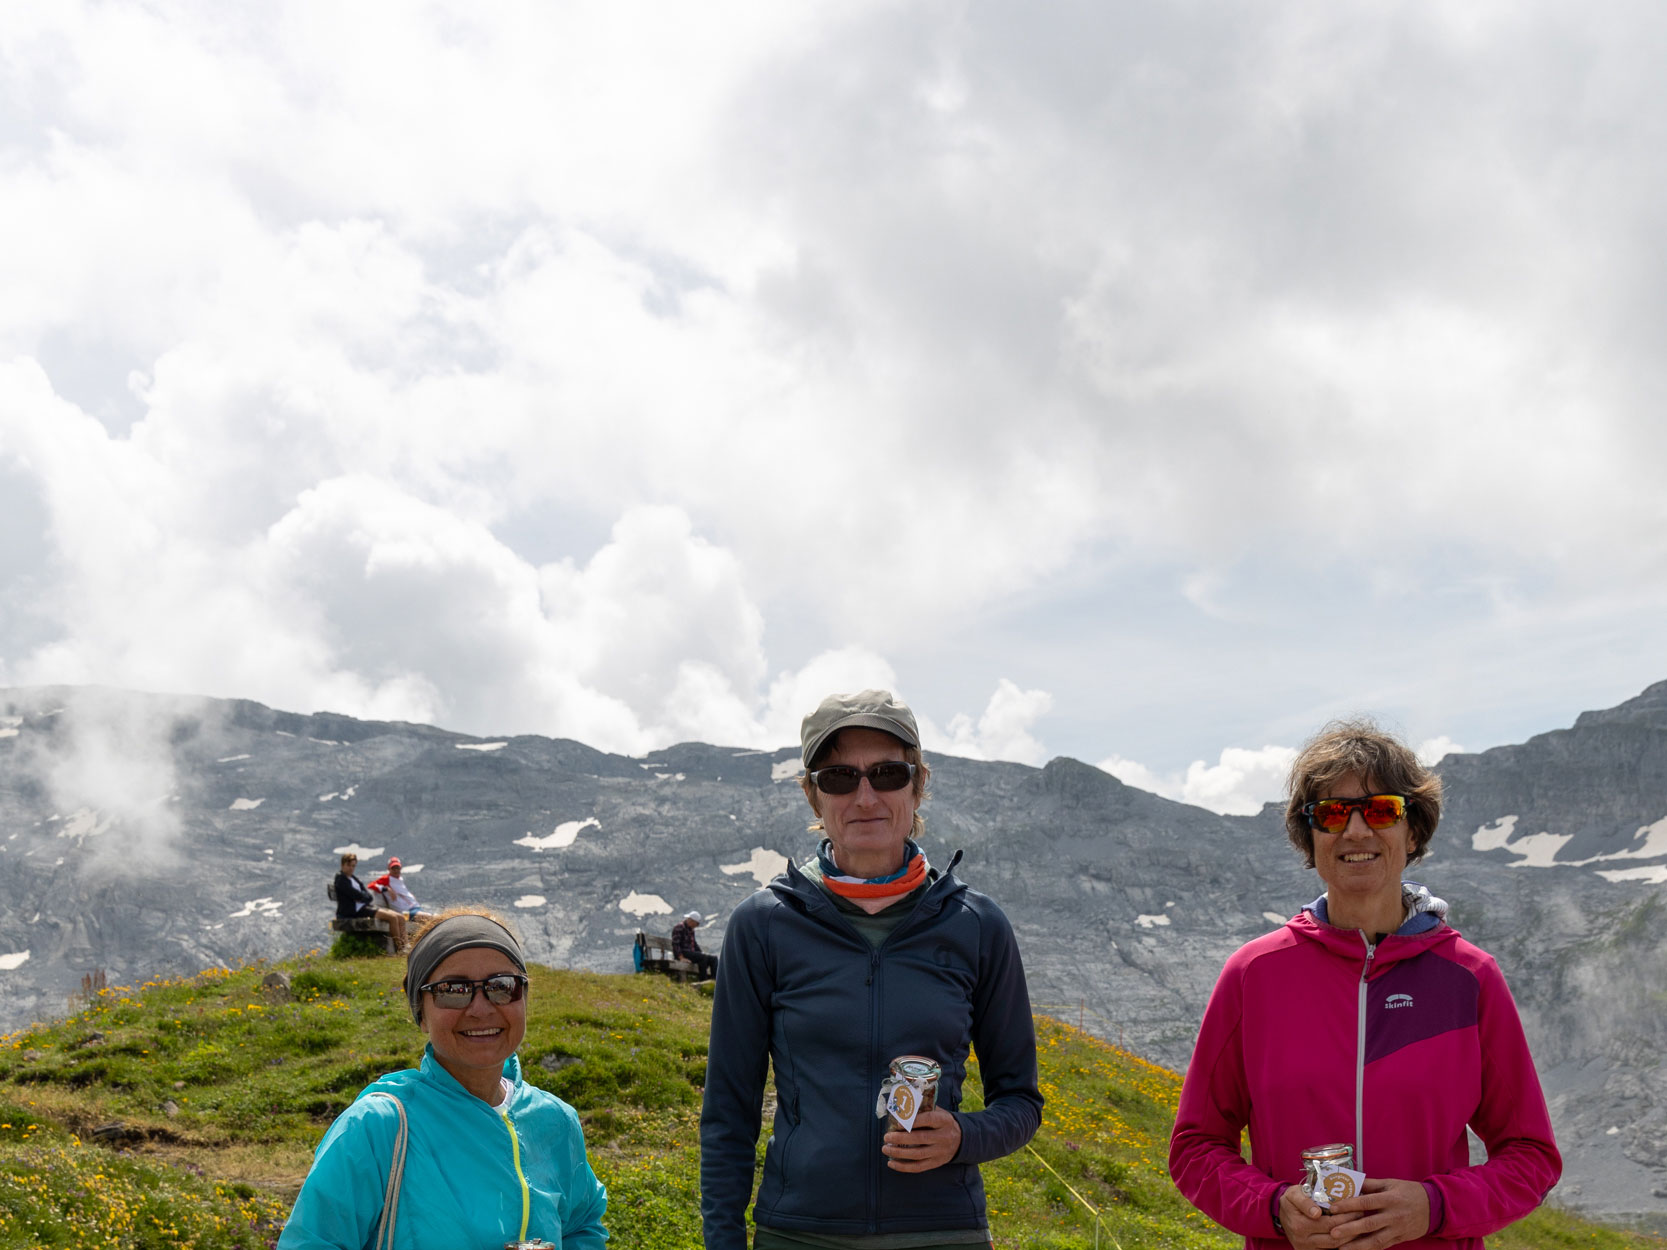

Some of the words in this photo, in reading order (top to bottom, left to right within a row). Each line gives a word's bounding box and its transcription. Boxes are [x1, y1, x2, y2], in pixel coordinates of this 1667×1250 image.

[1384, 1001, 1413, 1009] skinfit
[899, 1095, 907, 1111] 1
[1330, 1181, 1345, 1198] 2
